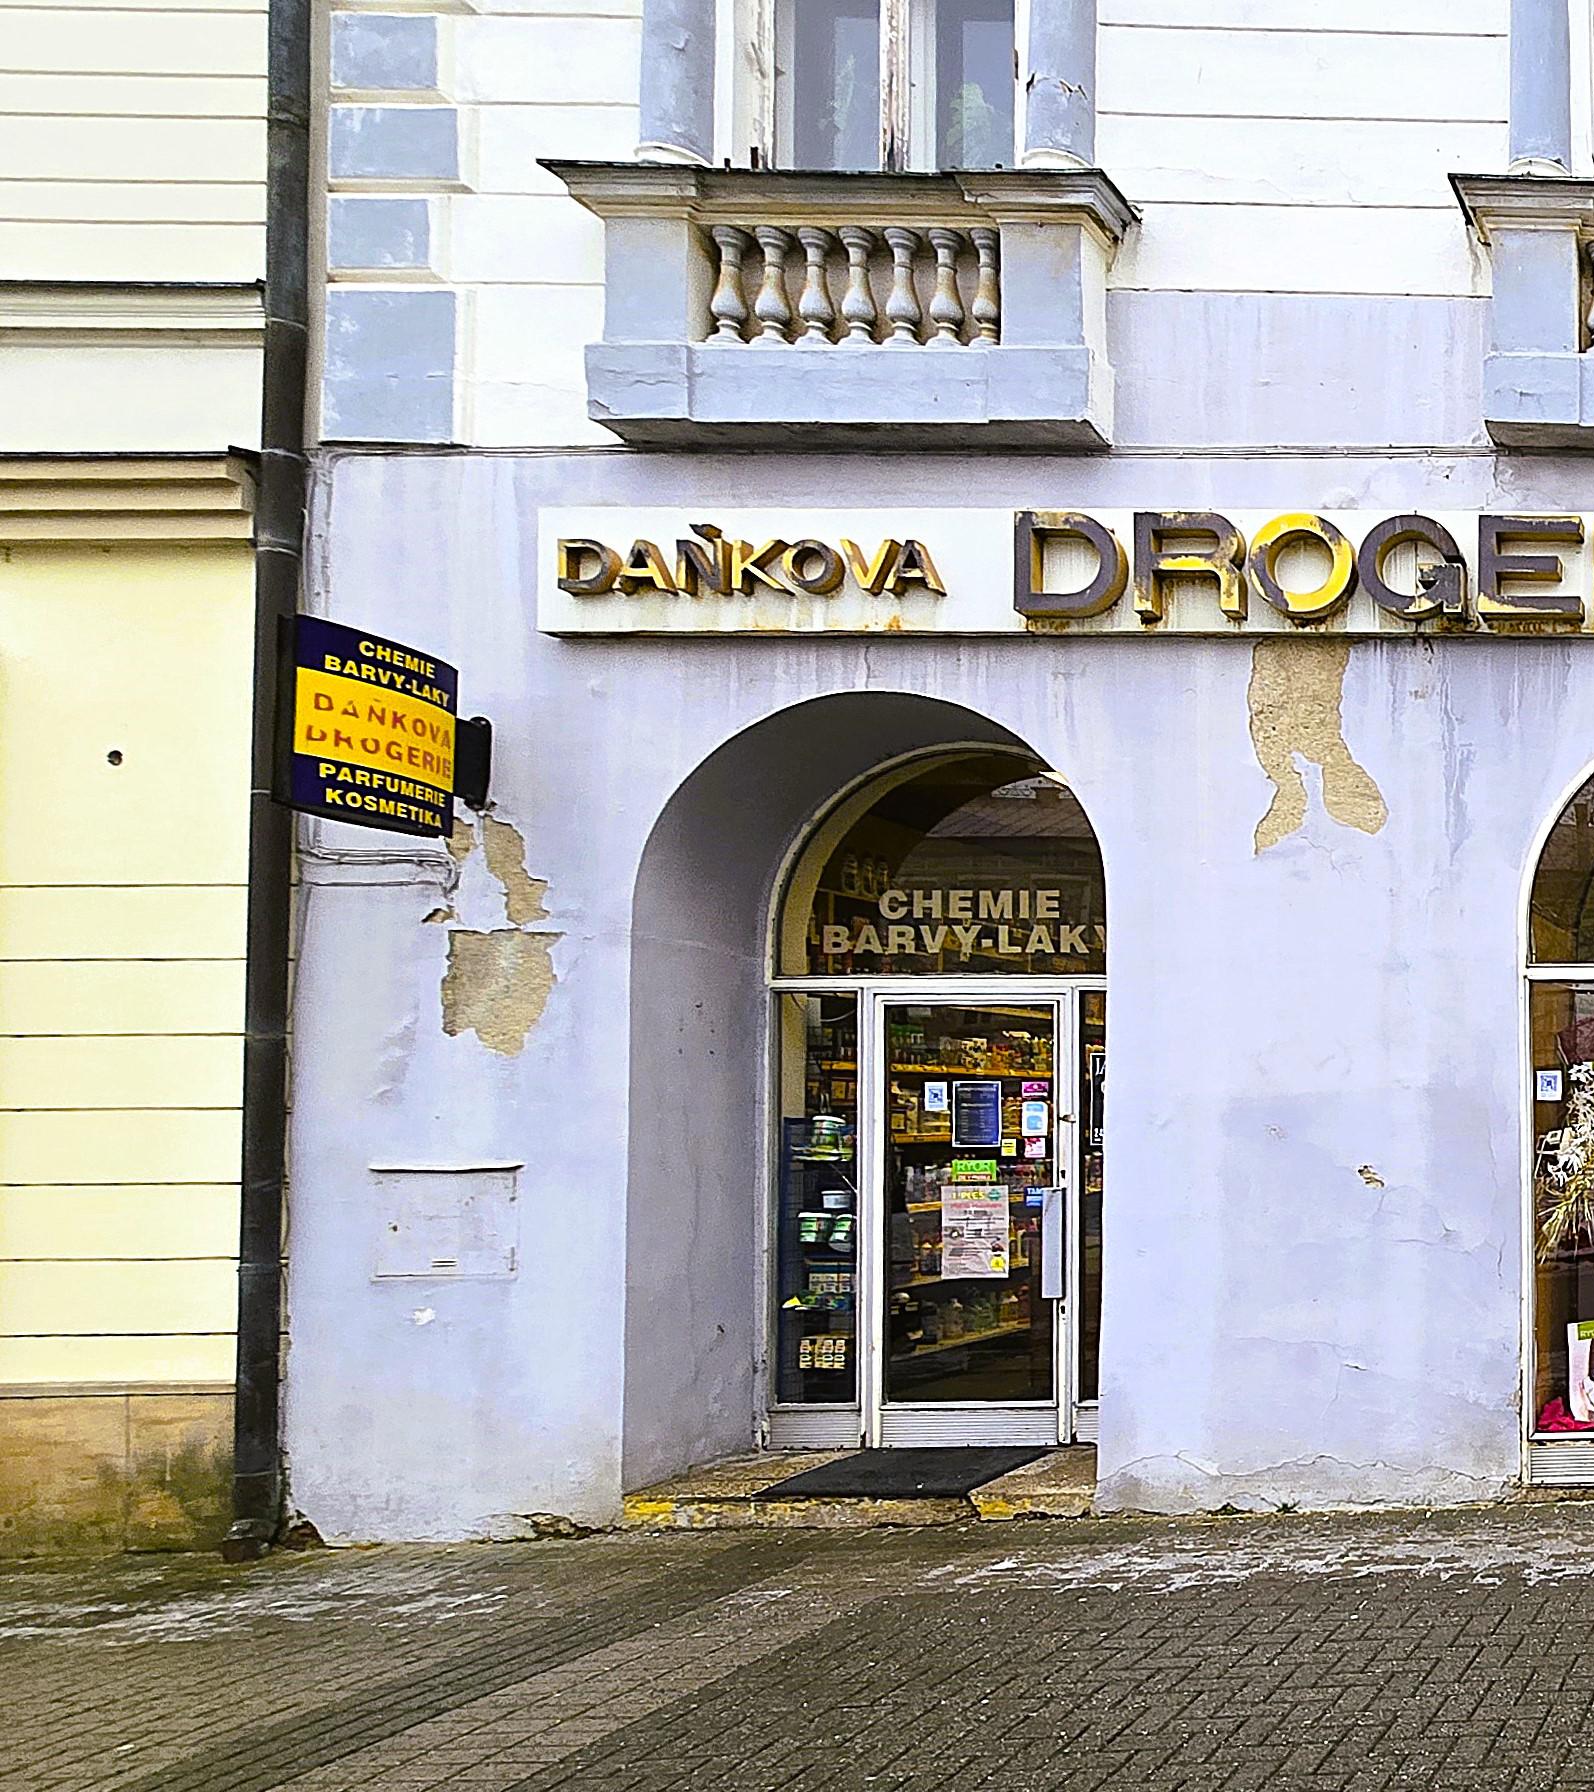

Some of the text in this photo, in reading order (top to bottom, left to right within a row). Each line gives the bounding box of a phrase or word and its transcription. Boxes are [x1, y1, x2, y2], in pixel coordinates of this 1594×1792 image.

[557, 523, 948, 597] DAŇKOVA
[324, 654, 450, 708] BARVY-LAKY
[358, 640, 436, 679] CHEMIE
[313, 691, 451, 749] DAŇKOVA
[305, 723, 451, 778] DROGERIE
[318, 762, 446, 808] PARFUMERIE
[325, 788, 443, 829] KOSMETIKA
[878, 889, 1061, 920] CHEMIE
[957, 1160, 991, 1172] RYOR
